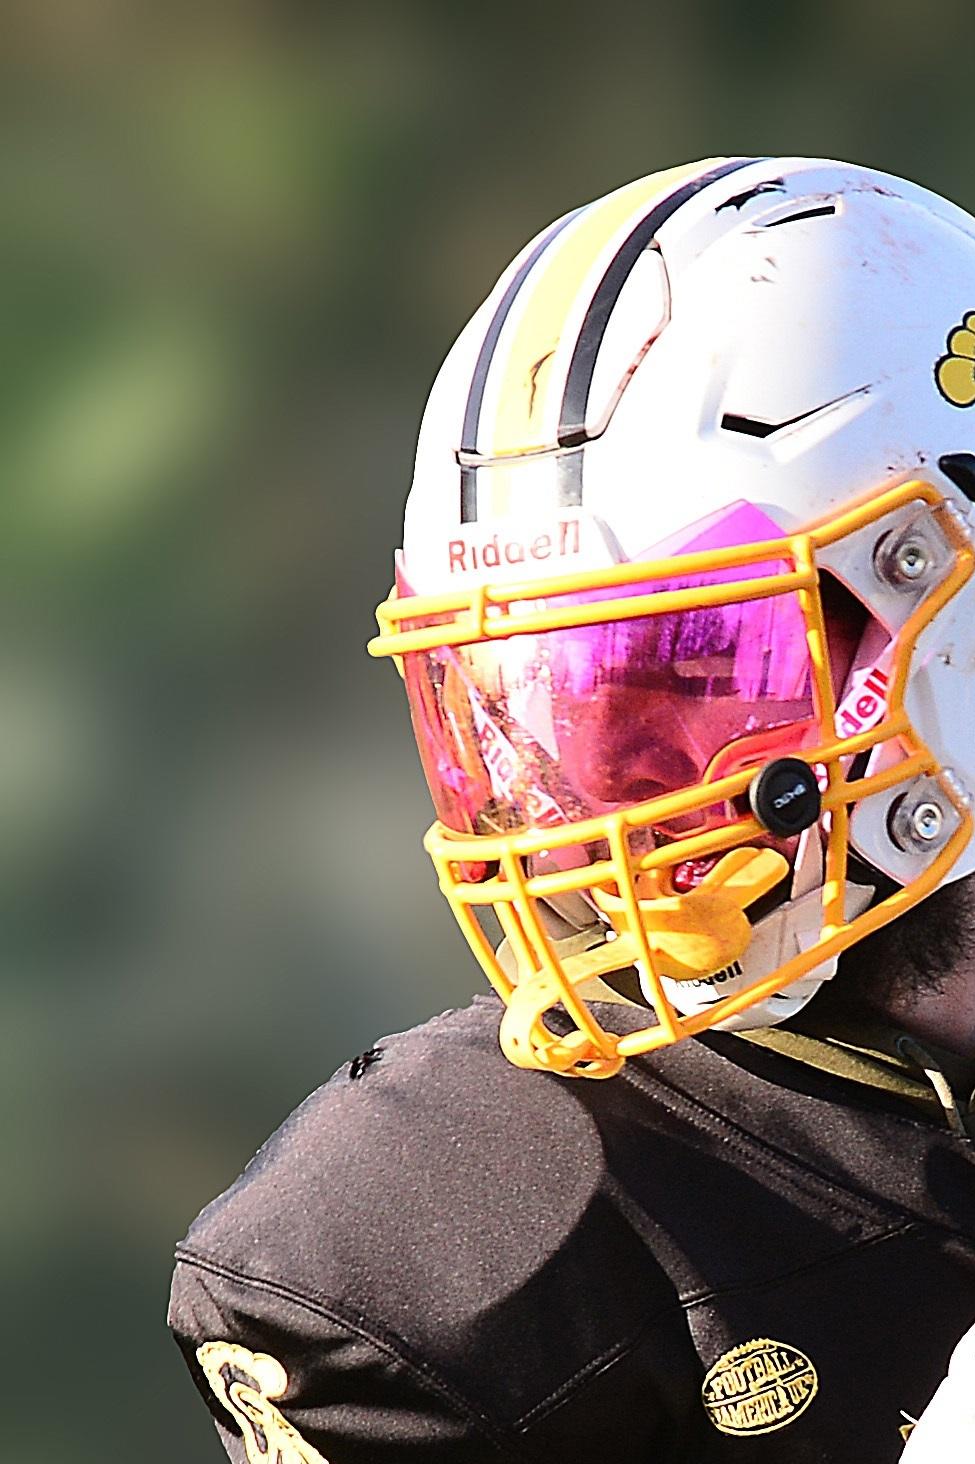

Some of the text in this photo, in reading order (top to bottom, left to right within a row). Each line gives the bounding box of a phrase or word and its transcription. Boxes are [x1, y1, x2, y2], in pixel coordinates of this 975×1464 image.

[841, 668, 889, 738] dell
[709, 1351, 797, 1400] FOOTBALL
[719, 1387, 795, 1429] AMERICA
